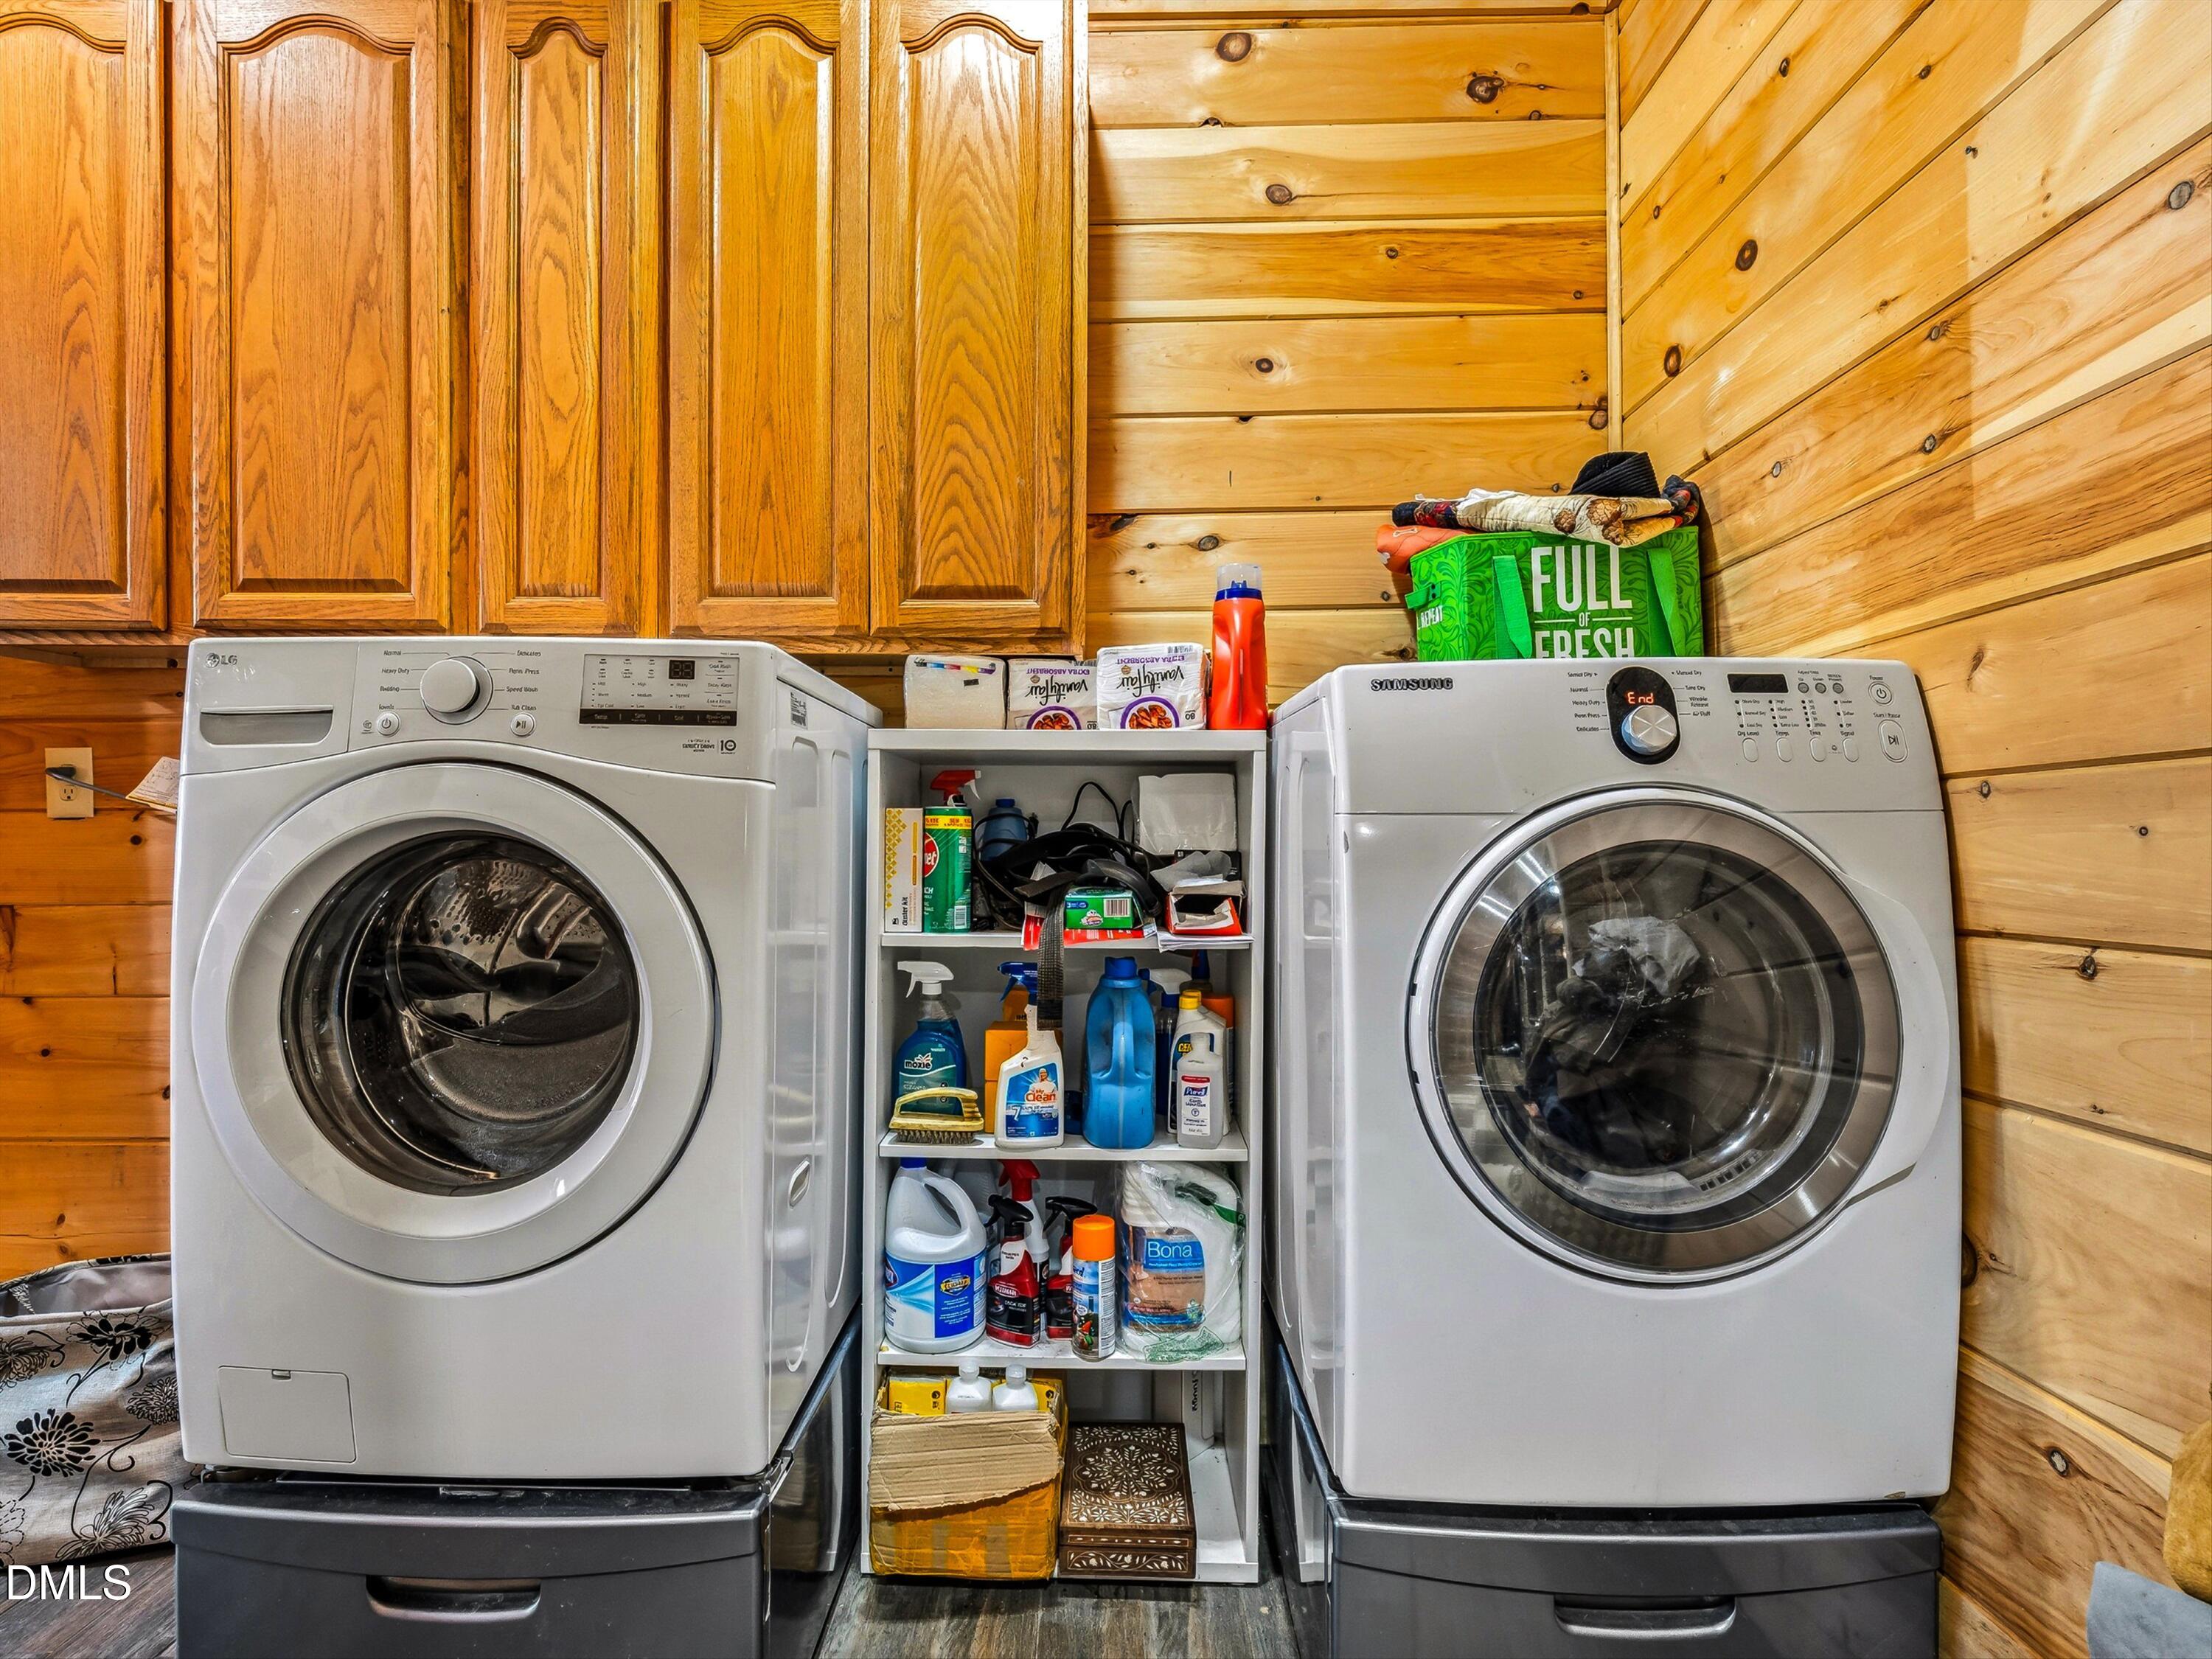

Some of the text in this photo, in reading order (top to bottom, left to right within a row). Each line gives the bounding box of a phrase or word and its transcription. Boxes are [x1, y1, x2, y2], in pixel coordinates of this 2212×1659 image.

[1531, 544, 1633, 613] FULL
[1579, 612, 1591, 627] OF
[1534, 627, 1635, 658] FRESH
[1116, 655, 1185, 664] EXTRA ABSORBENT
[1026, 667, 1067, 675] ABSORBENT
[1371, 678, 1454, 692] SAMSUNG
[1627, 692, 1654, 704] End
[1185, 712, 1196, 720] 80
[720, 740, 737, 751] 10
[905, 1060, 932, 1070] moxie
[1026, 1092, 1056, 1102] Clean
[1148, 1241, 1193, 1258] Bona
